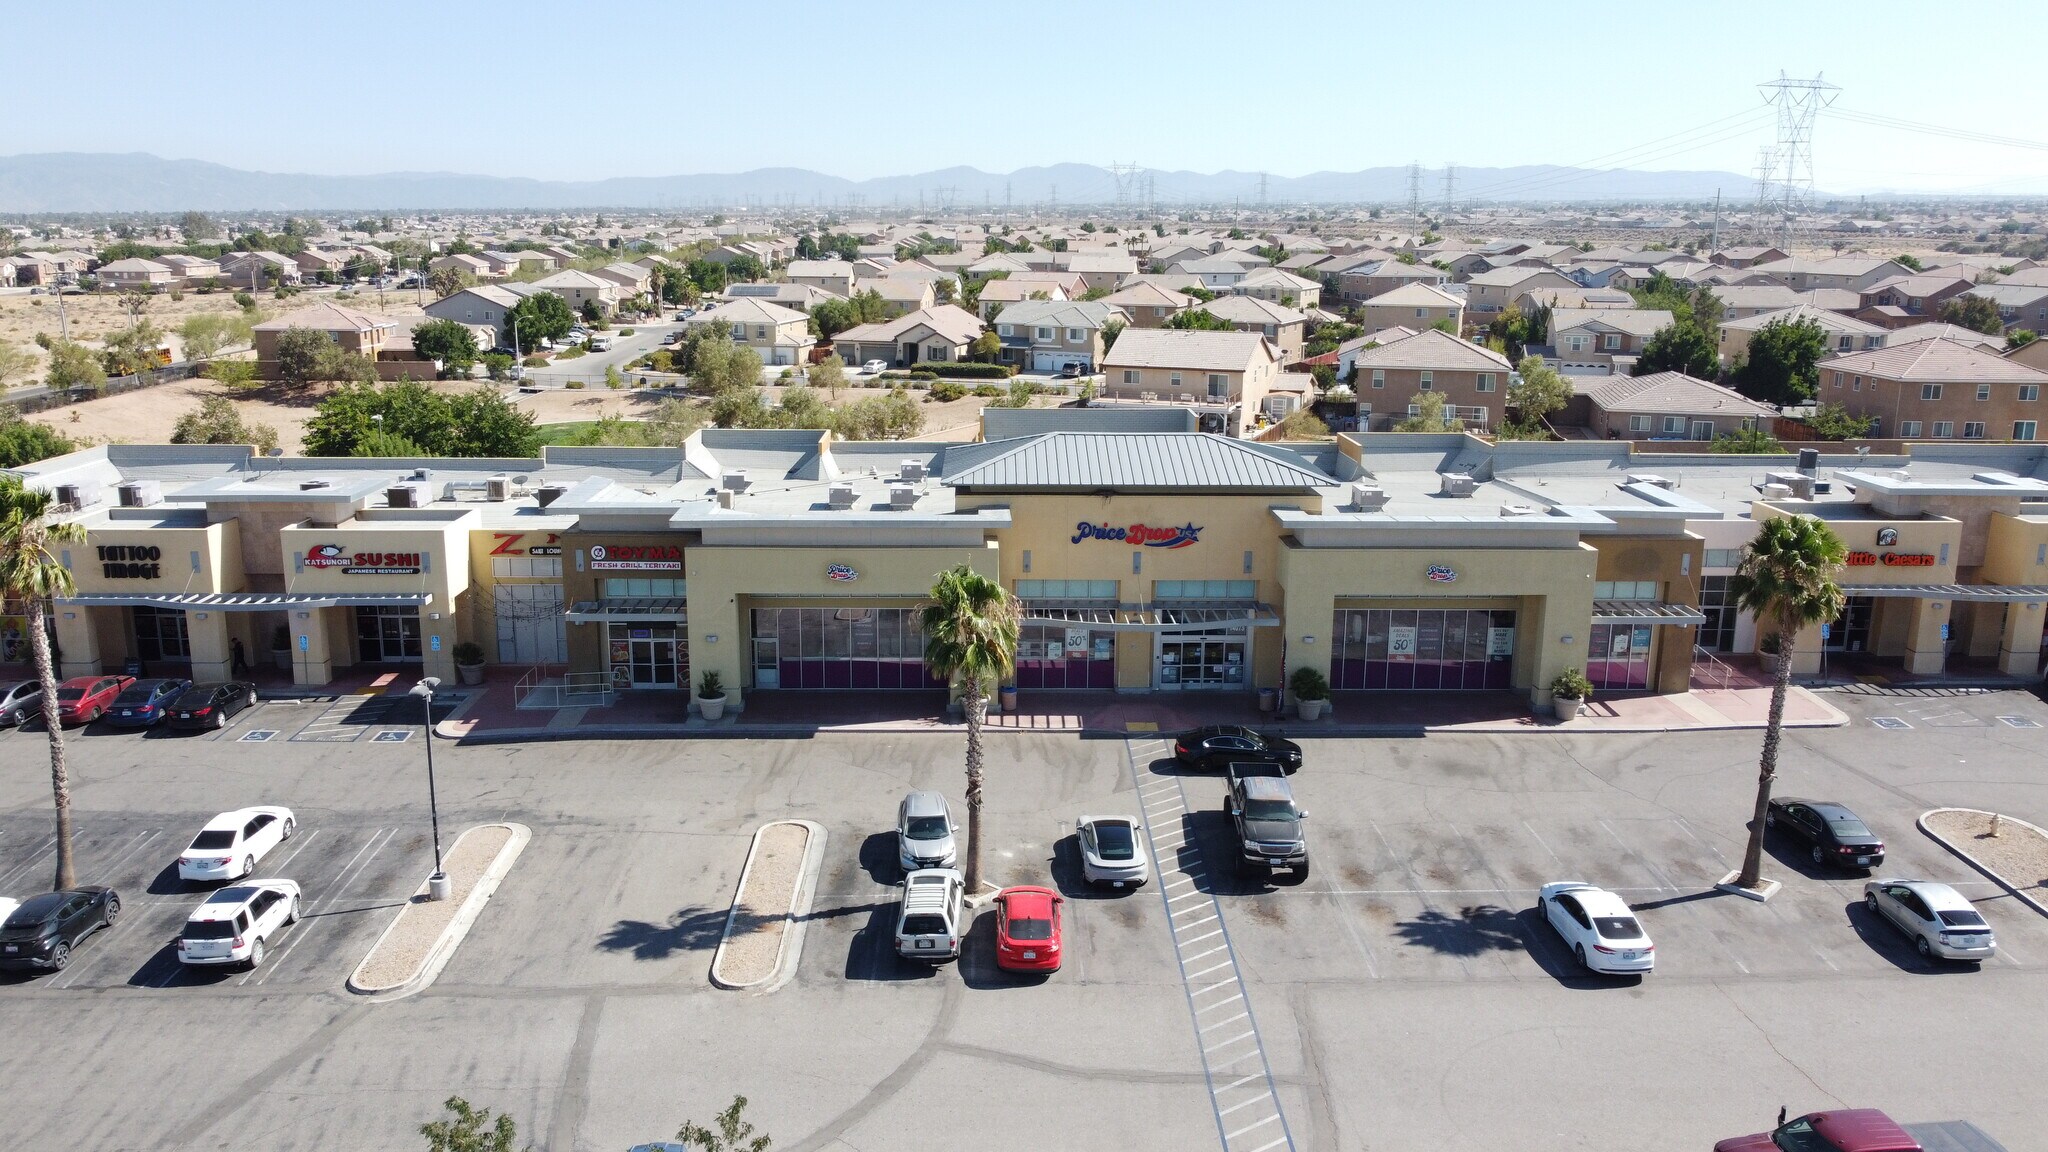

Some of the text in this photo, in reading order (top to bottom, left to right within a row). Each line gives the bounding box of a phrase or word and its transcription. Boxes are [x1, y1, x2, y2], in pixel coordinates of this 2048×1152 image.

[1071, 522, 1127, 544] Price
[1125, 523, 1179, 545] Drop
[96, 545, 161, 561] TATTOO
[354, 552, 420, 567] SUSHI
[607, 546, 681, 559] TOYMA
[1884, 552, 1935, 566] Caesars
[304, 559, 351, 567] KATSUNORI
[827, 564, 851, 574] Price
[1427, 565, 1451, 575] Price
[102, 563, 161, 580] IMAGE
